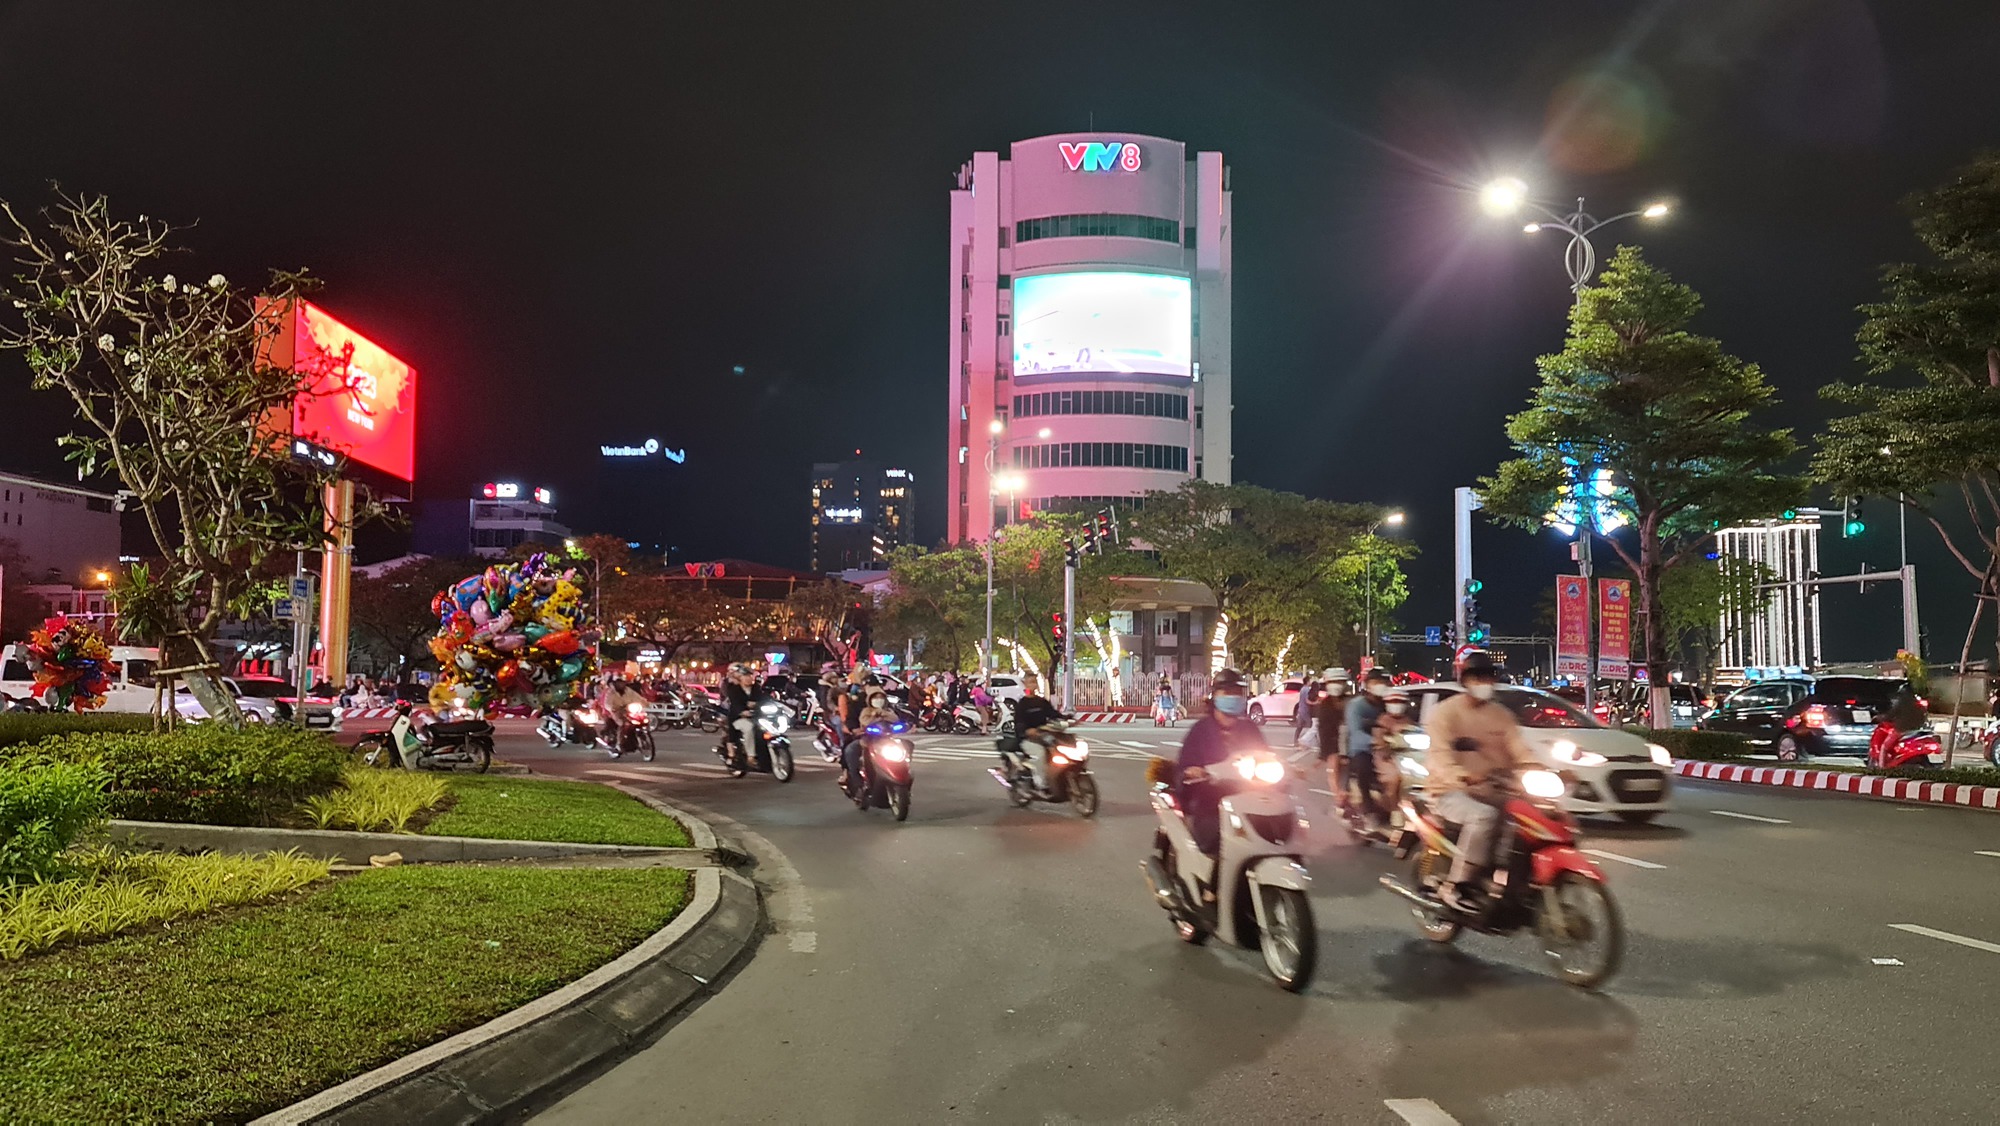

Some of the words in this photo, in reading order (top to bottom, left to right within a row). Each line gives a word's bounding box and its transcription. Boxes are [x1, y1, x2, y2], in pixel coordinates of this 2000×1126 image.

[1058, 142, 1141, 171] VTV8
[685, 562, 725, 578] VTV8
[1569, 662, 1587, 670] DRC
[1609, 664, 1628, 673] DRC
